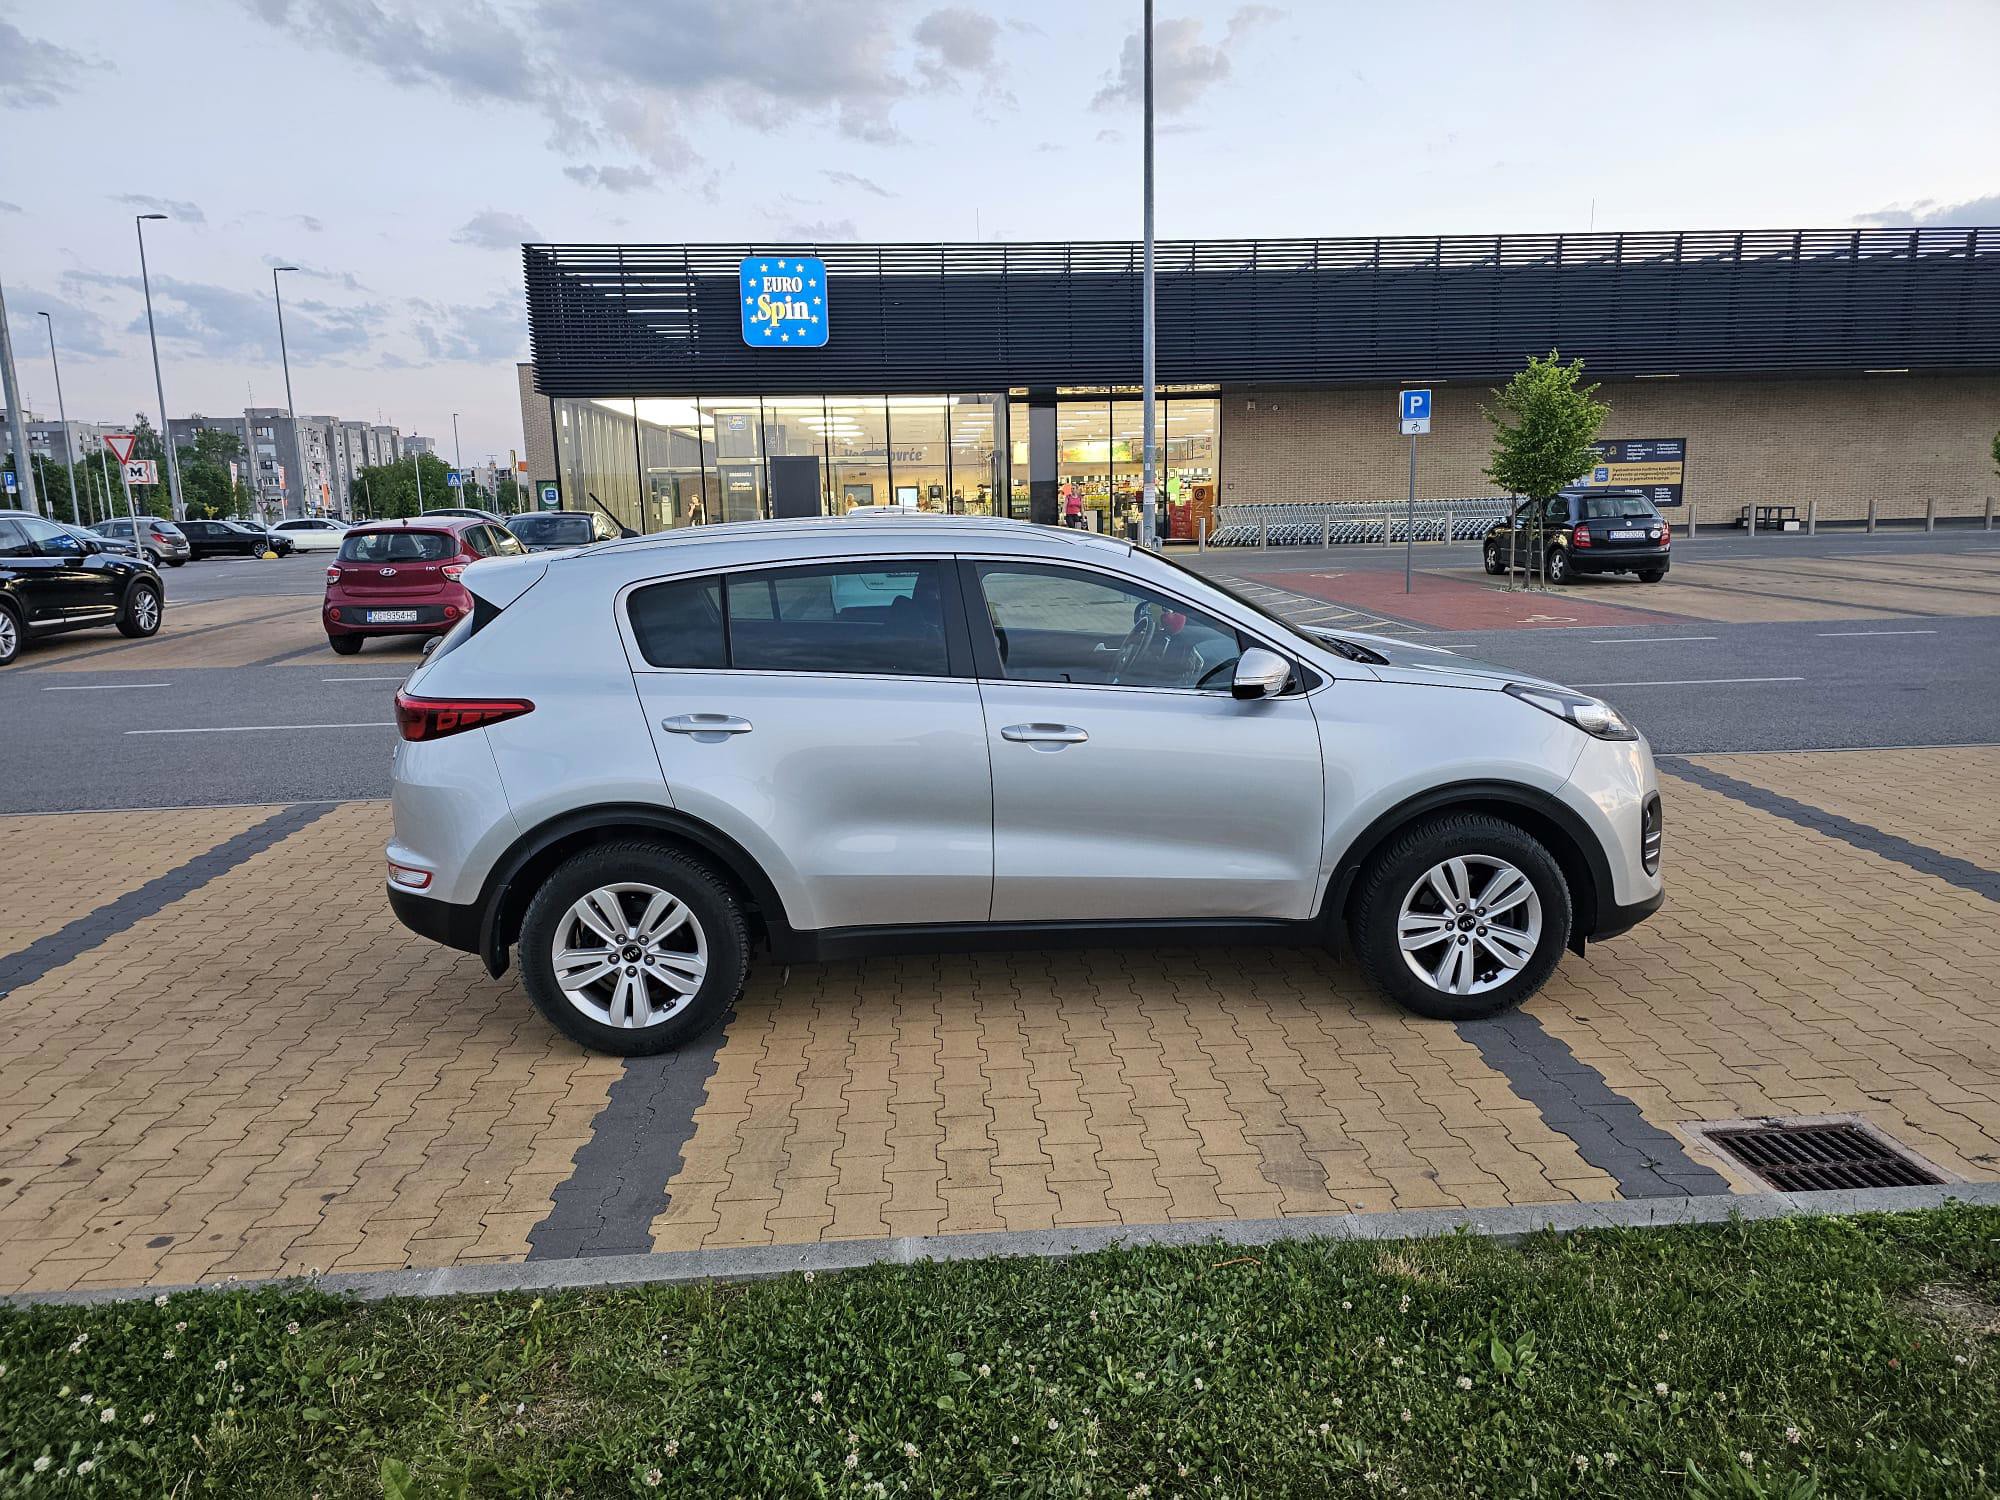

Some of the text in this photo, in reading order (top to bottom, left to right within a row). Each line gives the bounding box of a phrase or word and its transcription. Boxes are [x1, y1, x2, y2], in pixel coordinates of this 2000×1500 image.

[763, 277, 803, 293] EURO
[757, 294, 811, 327] Spin
[1410, 396, 1423, 414] P
[130, 467, 143, 477] M
[1460, 918, 1475, 928] KIA
[624, 947, 640, 960] KIA
